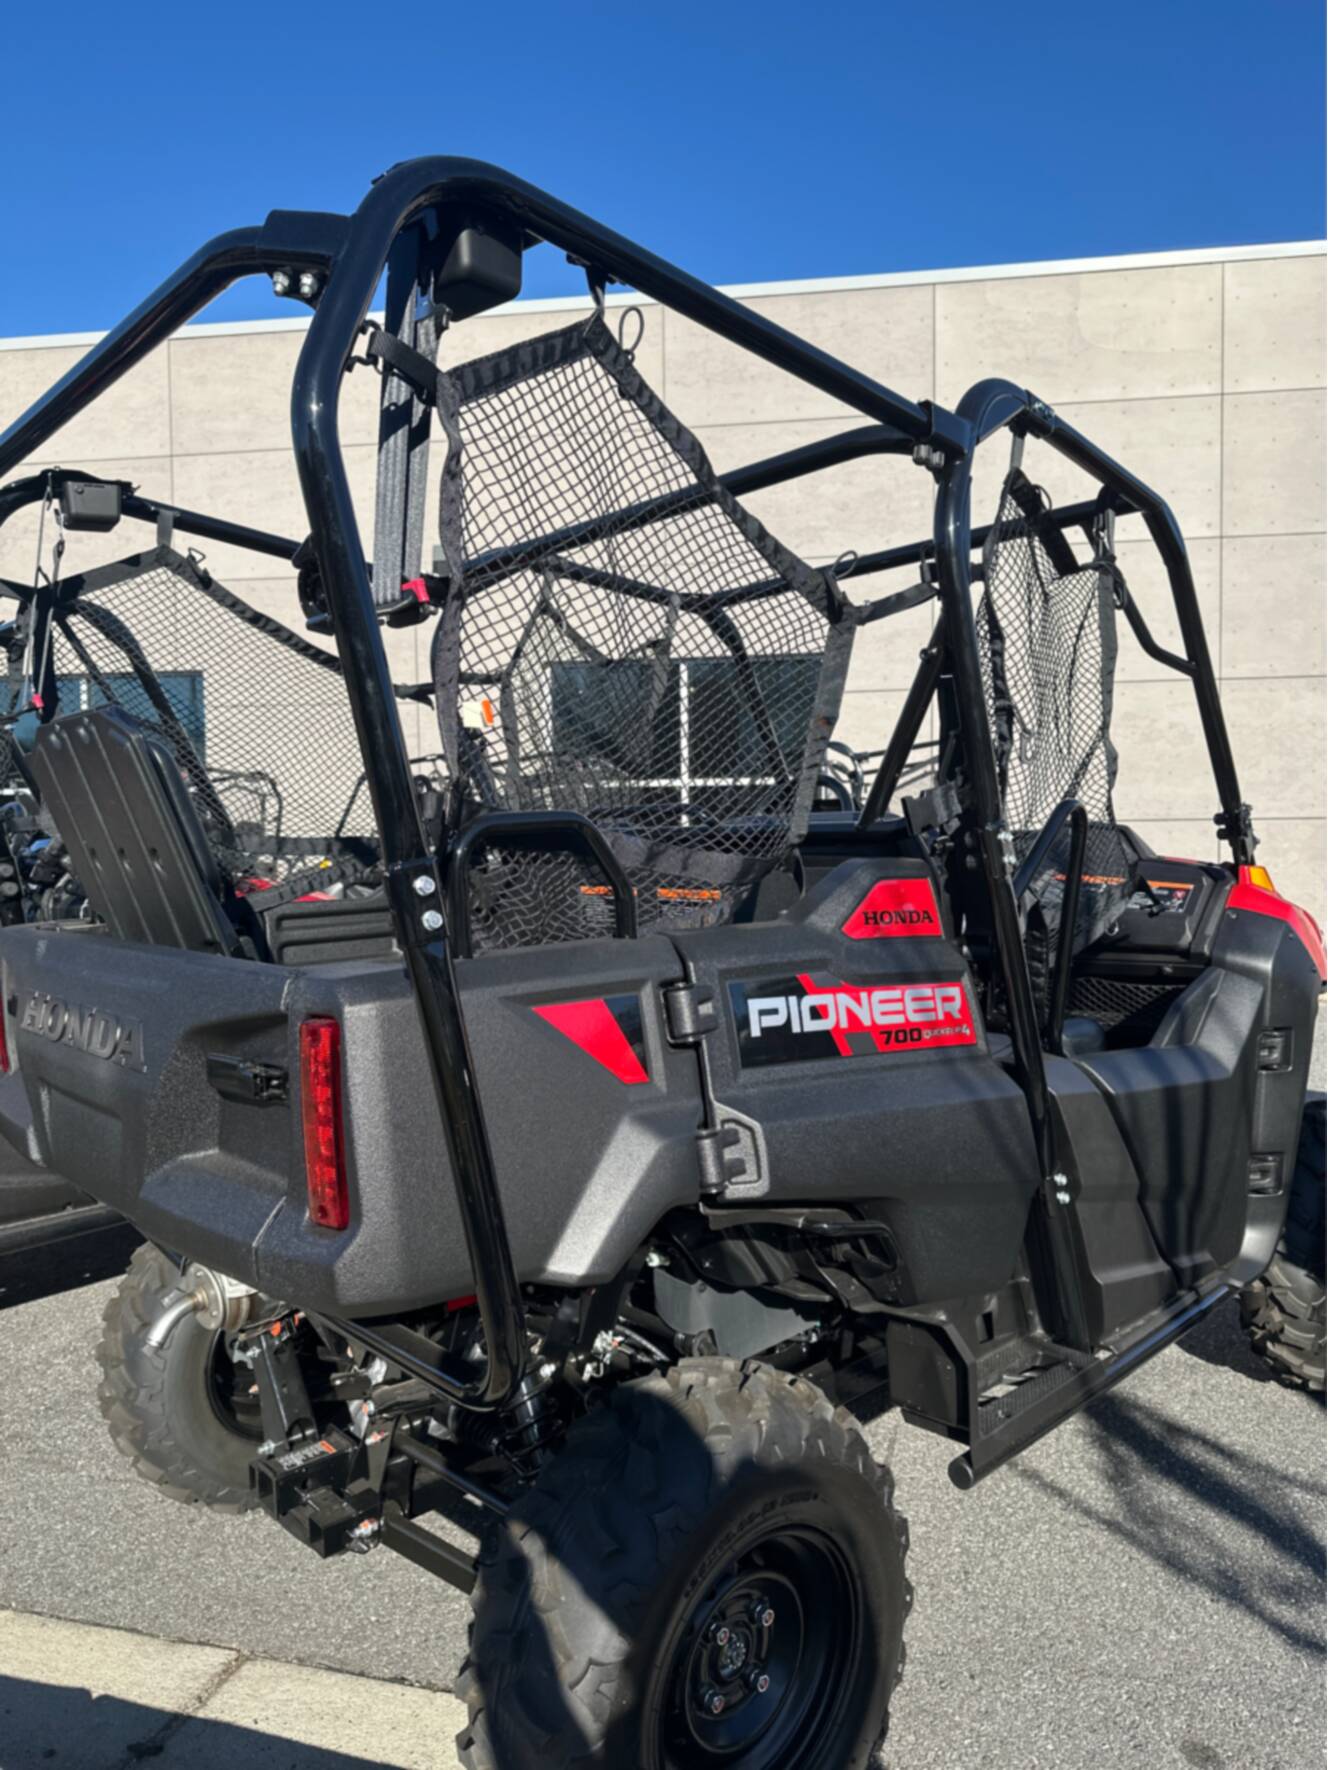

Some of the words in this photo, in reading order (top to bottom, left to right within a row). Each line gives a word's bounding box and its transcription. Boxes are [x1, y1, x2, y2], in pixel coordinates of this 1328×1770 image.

[863, 911, 934, 926] HONDA
[747, 987, 962, 1038] PIONEER
[21, 991, 148, 1073] HONDA
[879, 1028, 922, 1045] 700
